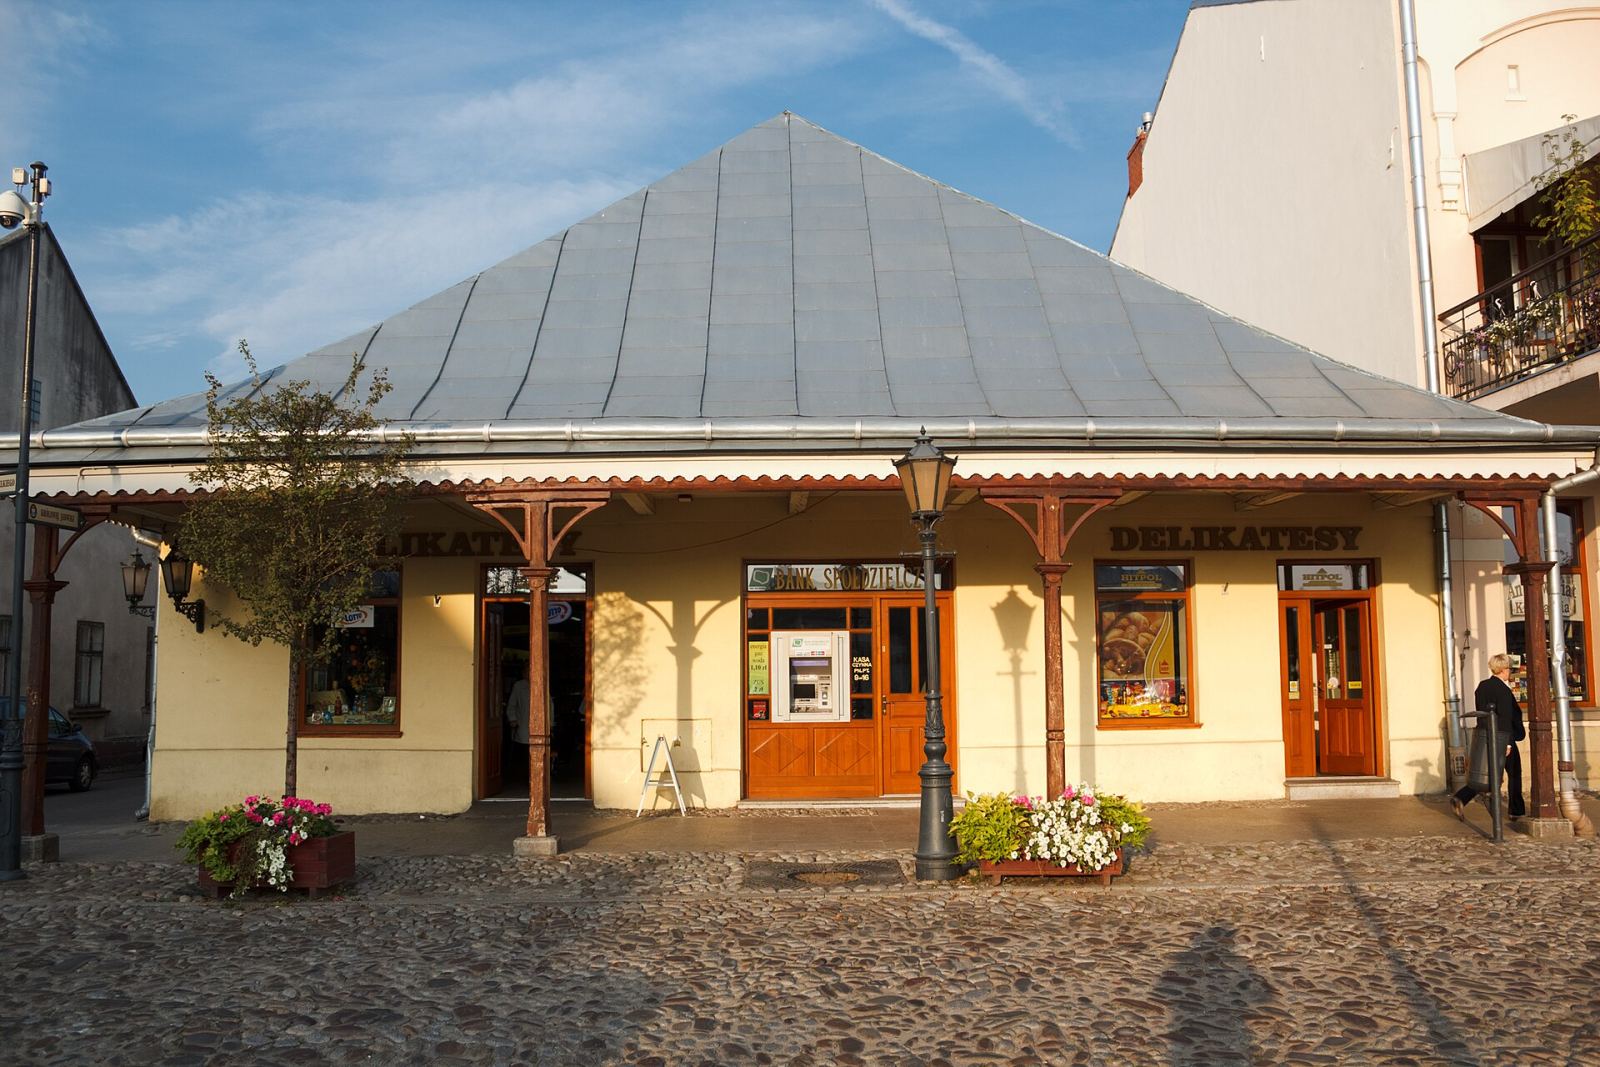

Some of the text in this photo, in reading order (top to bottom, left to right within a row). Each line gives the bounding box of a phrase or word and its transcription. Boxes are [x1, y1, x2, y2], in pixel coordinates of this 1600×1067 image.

[1109, 526, 1363, 551] DELIKATESY
[775, 565, 924, 590] BANK SPÓŁDZIELCZ
